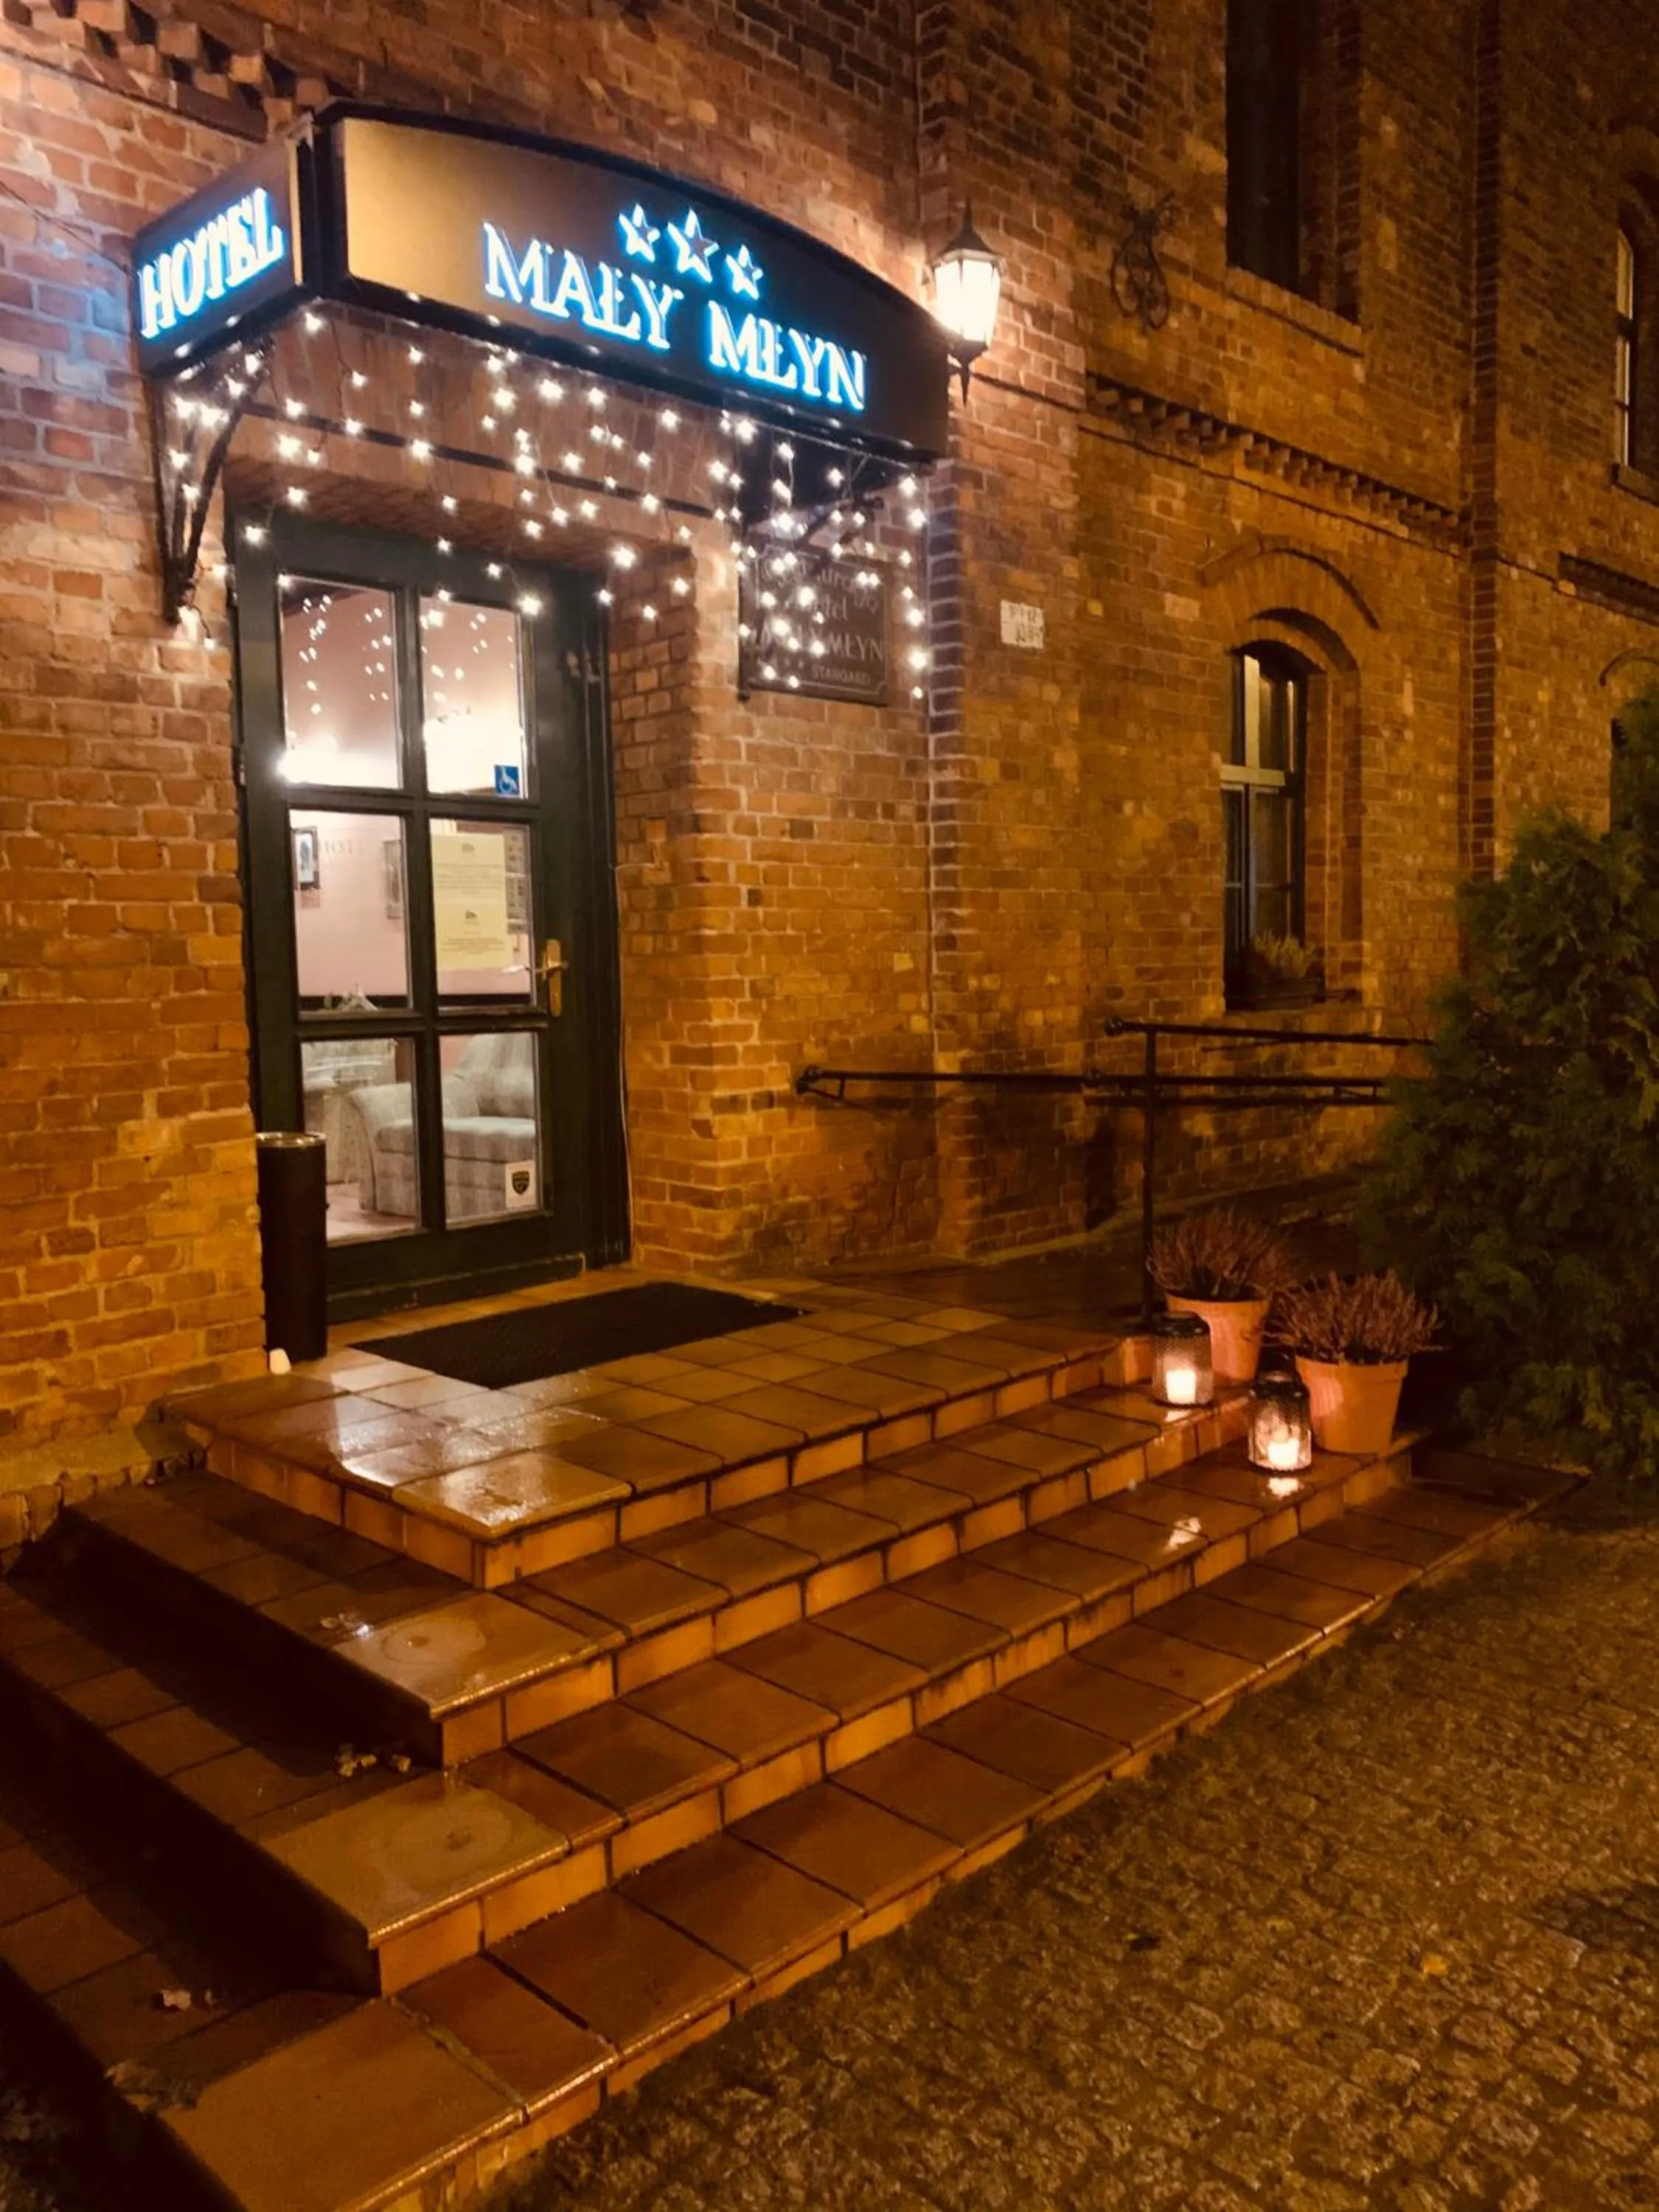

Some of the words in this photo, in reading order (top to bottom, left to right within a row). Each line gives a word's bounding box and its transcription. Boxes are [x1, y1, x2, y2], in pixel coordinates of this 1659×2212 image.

[139, 187, 283, 338] HOTEL
[483, 222, 683, 349] MAŁY
[709, 300, 865, 409] MŁYN
